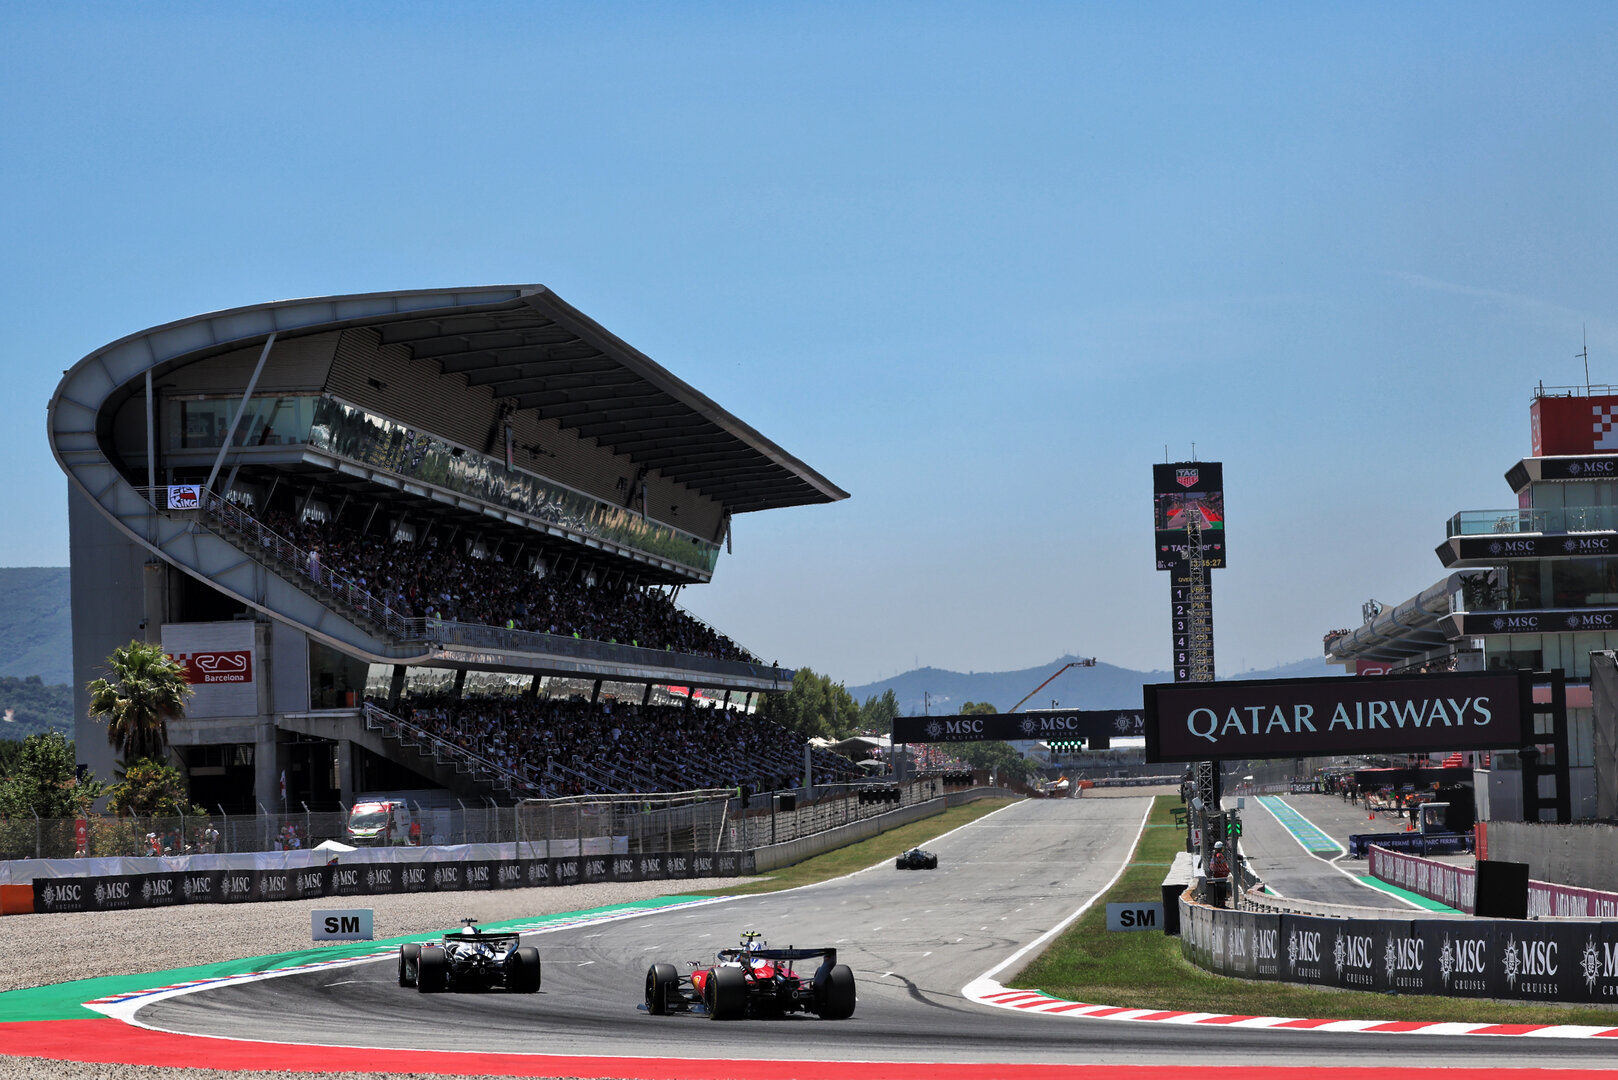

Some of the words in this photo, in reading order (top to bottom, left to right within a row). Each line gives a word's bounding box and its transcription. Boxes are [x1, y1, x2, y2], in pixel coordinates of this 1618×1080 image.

[1584, 462, 1614, 472] MSC
[1505, 541, 1535, 551] MSC
[1579, 539, 1609, 549] MSC
[1177, 590, 1182, 598] 1
[1177, 606, 1183, 615] 2
[1178, 621, 1184, 630] 3
[1508, 617, 1538, 627] MSC
[1582, 614, 1612, 625] MSC
[1178, 637, 1184, 646] 4
[1179, 653, 1185, 662] 5
[205, 674, 244, 682] Barcelona
[1179, 669, 1186, 678] 6
[946, 720, 984, 734] MSC
[1040, 717, 1078, 731] MSC
[1187, 703, 1317, 742] QATAR
[1328, 697, 1492, 731] AIRWAYS
[304, 873, 322, 889] MSC
[340, 870, 358, 886] MSC
[375, 869, 392, 884] MSC
[409, 868, 426, 883] MSC
[441, 867, 457, 882] MSC
[474, 866, 490, 881] MSC
[106, 882, 130, 899] MSC
[152, 880, 173, 895] MSC
[192, 877, 211, 893] MSC
[231, 877, 250, 892] MSC
[268, 876, 287, 891] MSC
[56, 885, 81, 901] MSC
[324, 916, 360, 934] SM
[1120, 909, 1155, 927] SM
[1259, 929, 1277, 959] MSC
[1299, 931, 1321, 962] MSC
[1346, 935, 1373, 969] MSC
[1397, 938, 1424, 971] MSC
[1455, 939, 1486, 973] MSC
[1521, 941, 1558, 976] MSC
[1298, 967, 1321, 978] CRUISES
[1346, 976, 1373, 985] CRUISES
[1396, 977, 1424, 988] CRUISES
[1455, 980, 1486, 990] CRUISES
[1521, 983, 1558, 994] CRUISES
